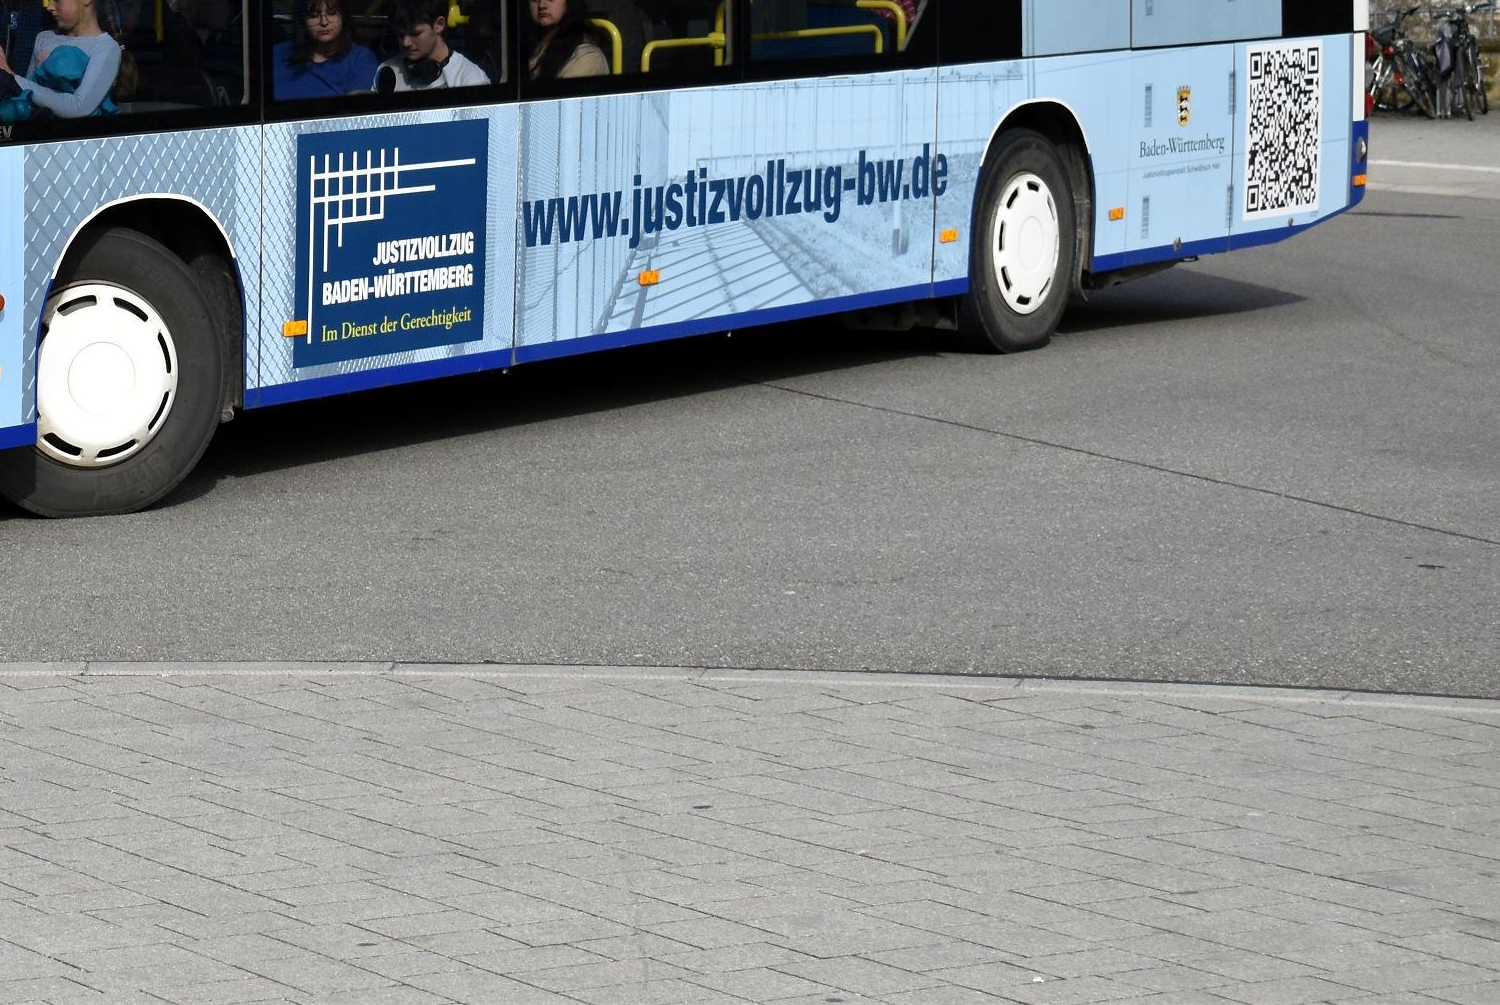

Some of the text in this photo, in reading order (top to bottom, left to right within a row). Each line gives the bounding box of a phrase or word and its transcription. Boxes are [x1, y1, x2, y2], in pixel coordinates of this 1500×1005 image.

[1139, 133, 1225, 158] Baden-Württemberg
[522, 143, 948, 249] www.justizvollzug-bw.de
[372, 231, 474, 266] JUSTIZVOLLZUG
[322, 263, 473, 306] BADEN-WÜRTTEMBERG
[321, 306, 473, 343] Im Dienst der Gerechtigkeit
